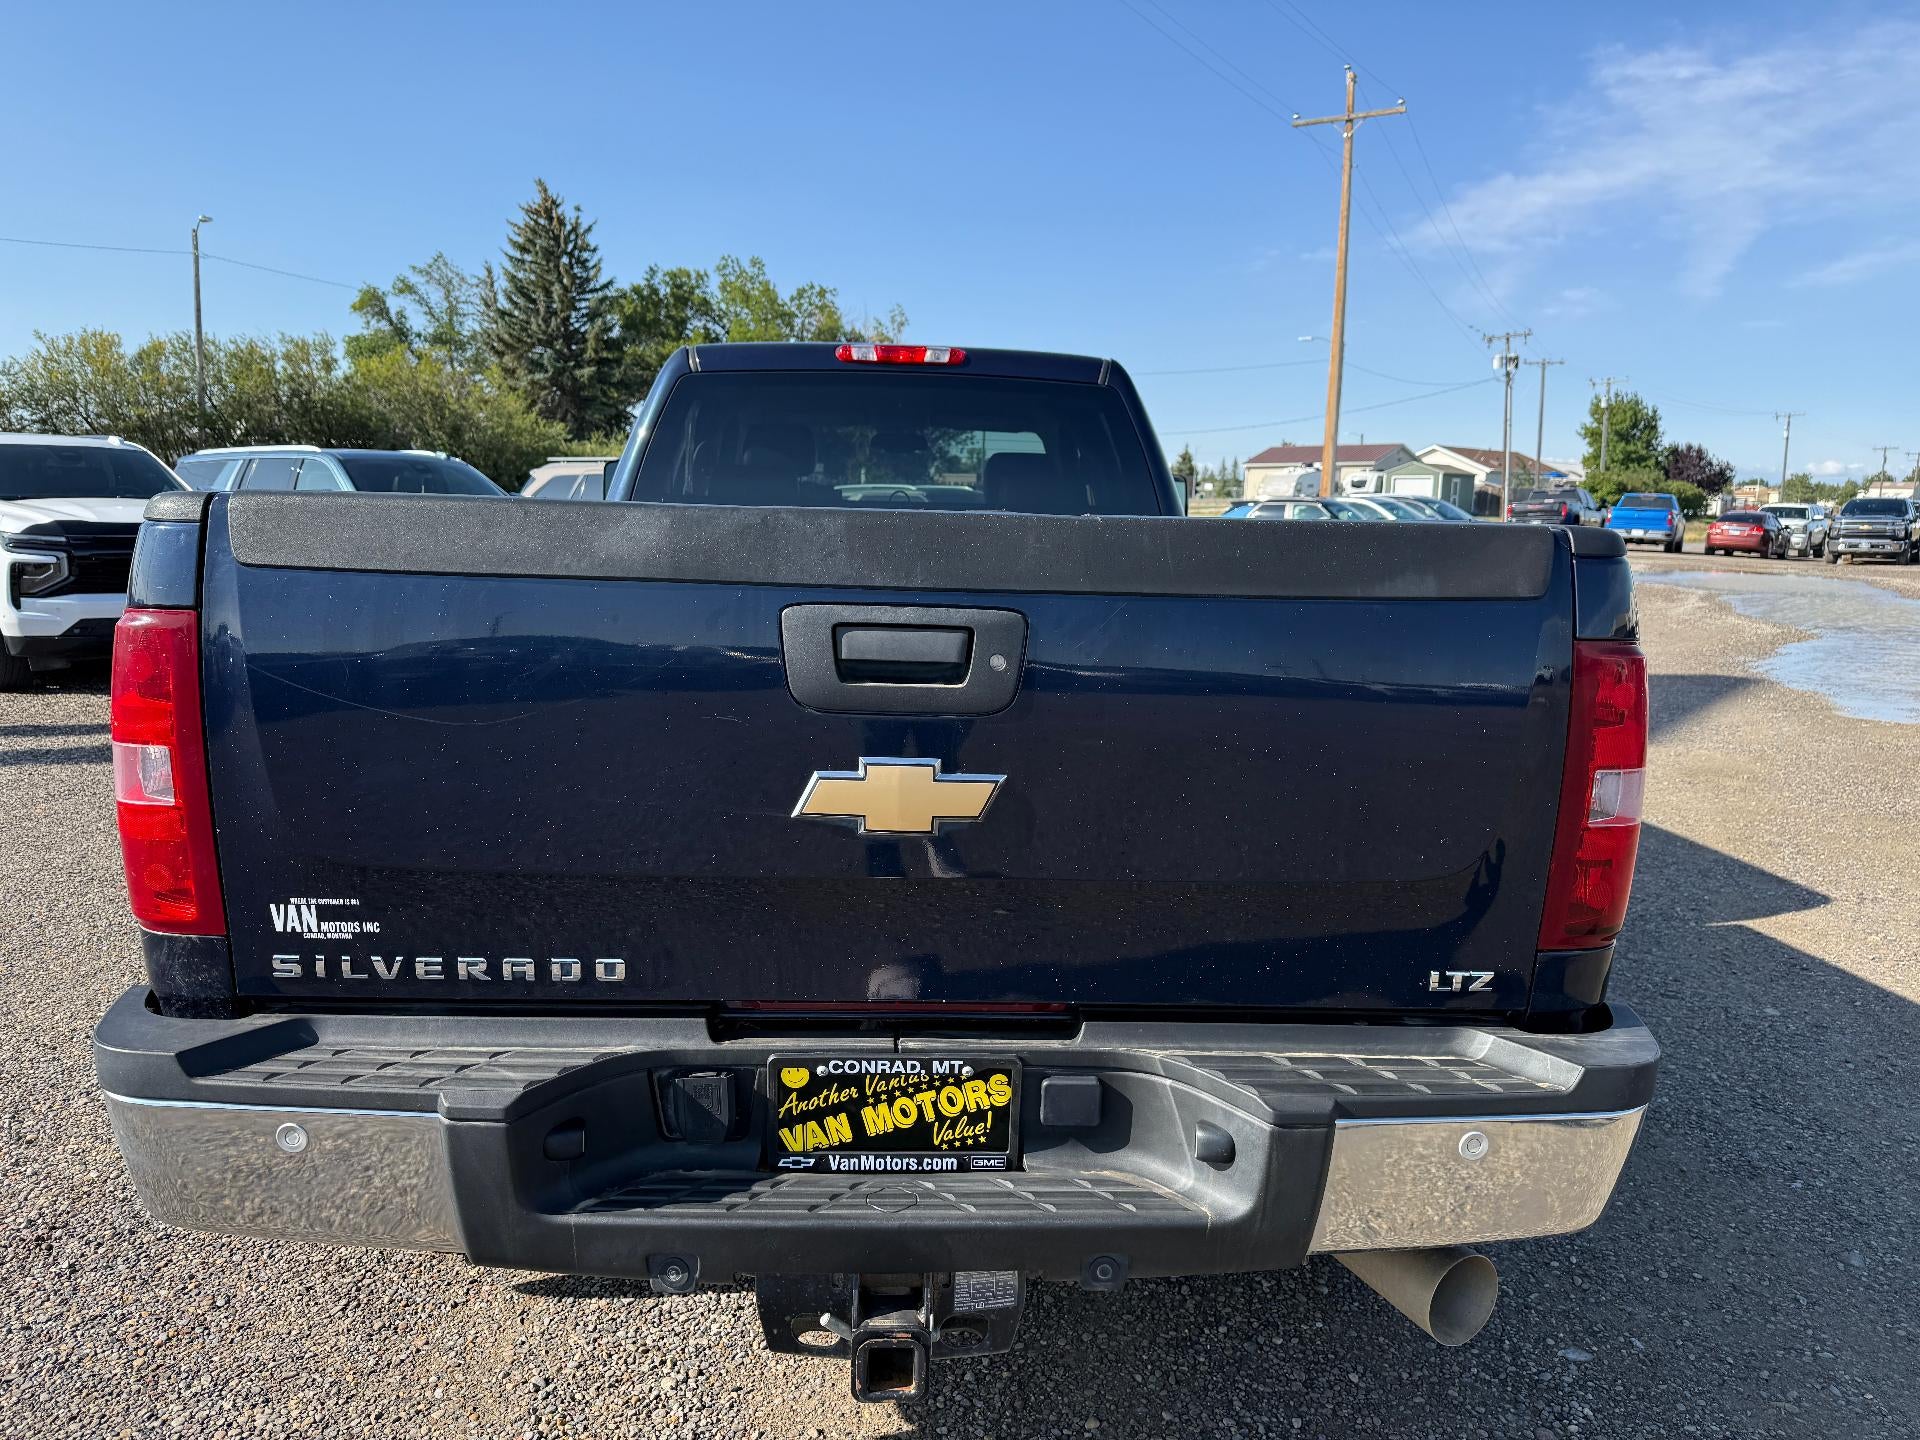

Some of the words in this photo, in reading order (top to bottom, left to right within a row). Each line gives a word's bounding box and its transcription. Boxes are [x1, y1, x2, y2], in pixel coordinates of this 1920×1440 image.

[317, 898, 344, 906] CUSTOMER
[269, 903, 319, 932] VAN
[320, 921, 361, 933] MOTORS
[362, 921, 381, 933] INC
[272, 954, 627, 982] SILVERADO
[1429, 970, 1495, 992] LTZ
[828, 1060, 926, 1075] CONRAD,
[778, 1083, 859, 1119] Another
[779, 1112, 853, 1153] VAN
[861, 1073, 1013, 1137] MOTORS
[933, 1110, 993, 1146] Value!
[828, 1155, 958, 1171] VanMotors.com
[972, 1159, 1005, 1168] GMC
